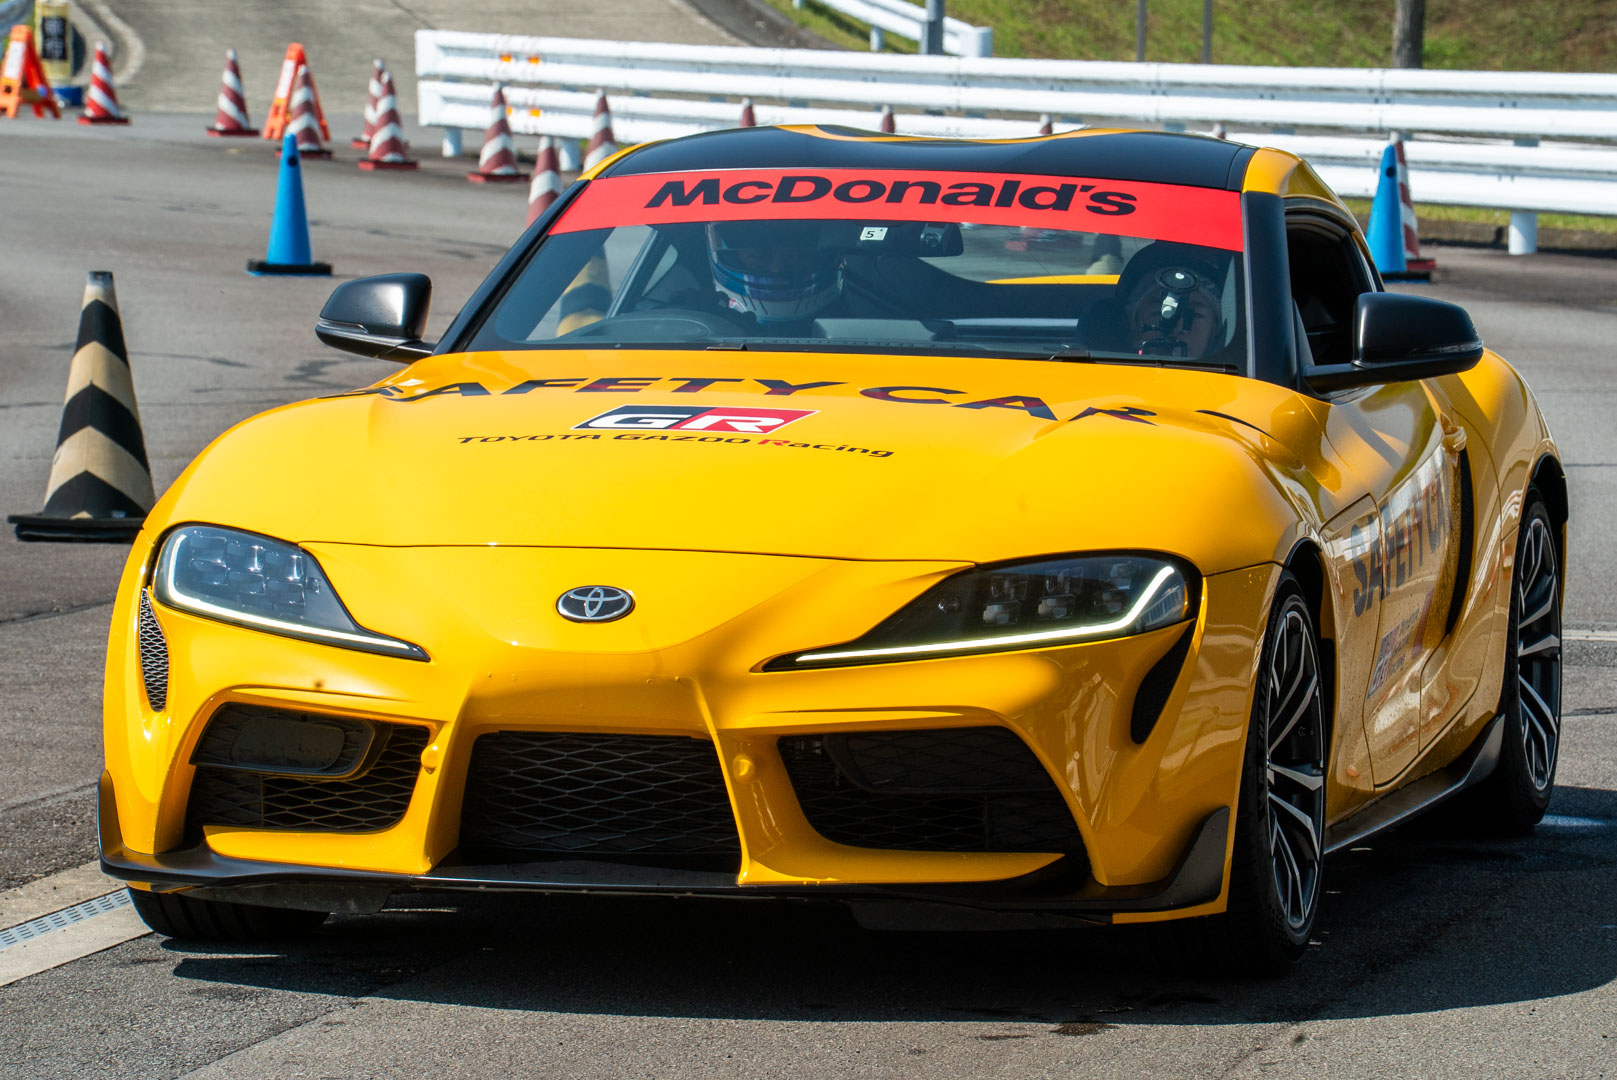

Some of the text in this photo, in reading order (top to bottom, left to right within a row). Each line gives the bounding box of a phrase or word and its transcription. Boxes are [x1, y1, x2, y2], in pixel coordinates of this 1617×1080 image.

[644, 176, 1138, 215] McDonald's
[588, 413, 785, 433] GR
[859, 386, 1158, 427] CAR
[458, 434, 895, 458] TOYOTA GAZOO Racing
[1350, 472, 1424, 618] SAFETY
